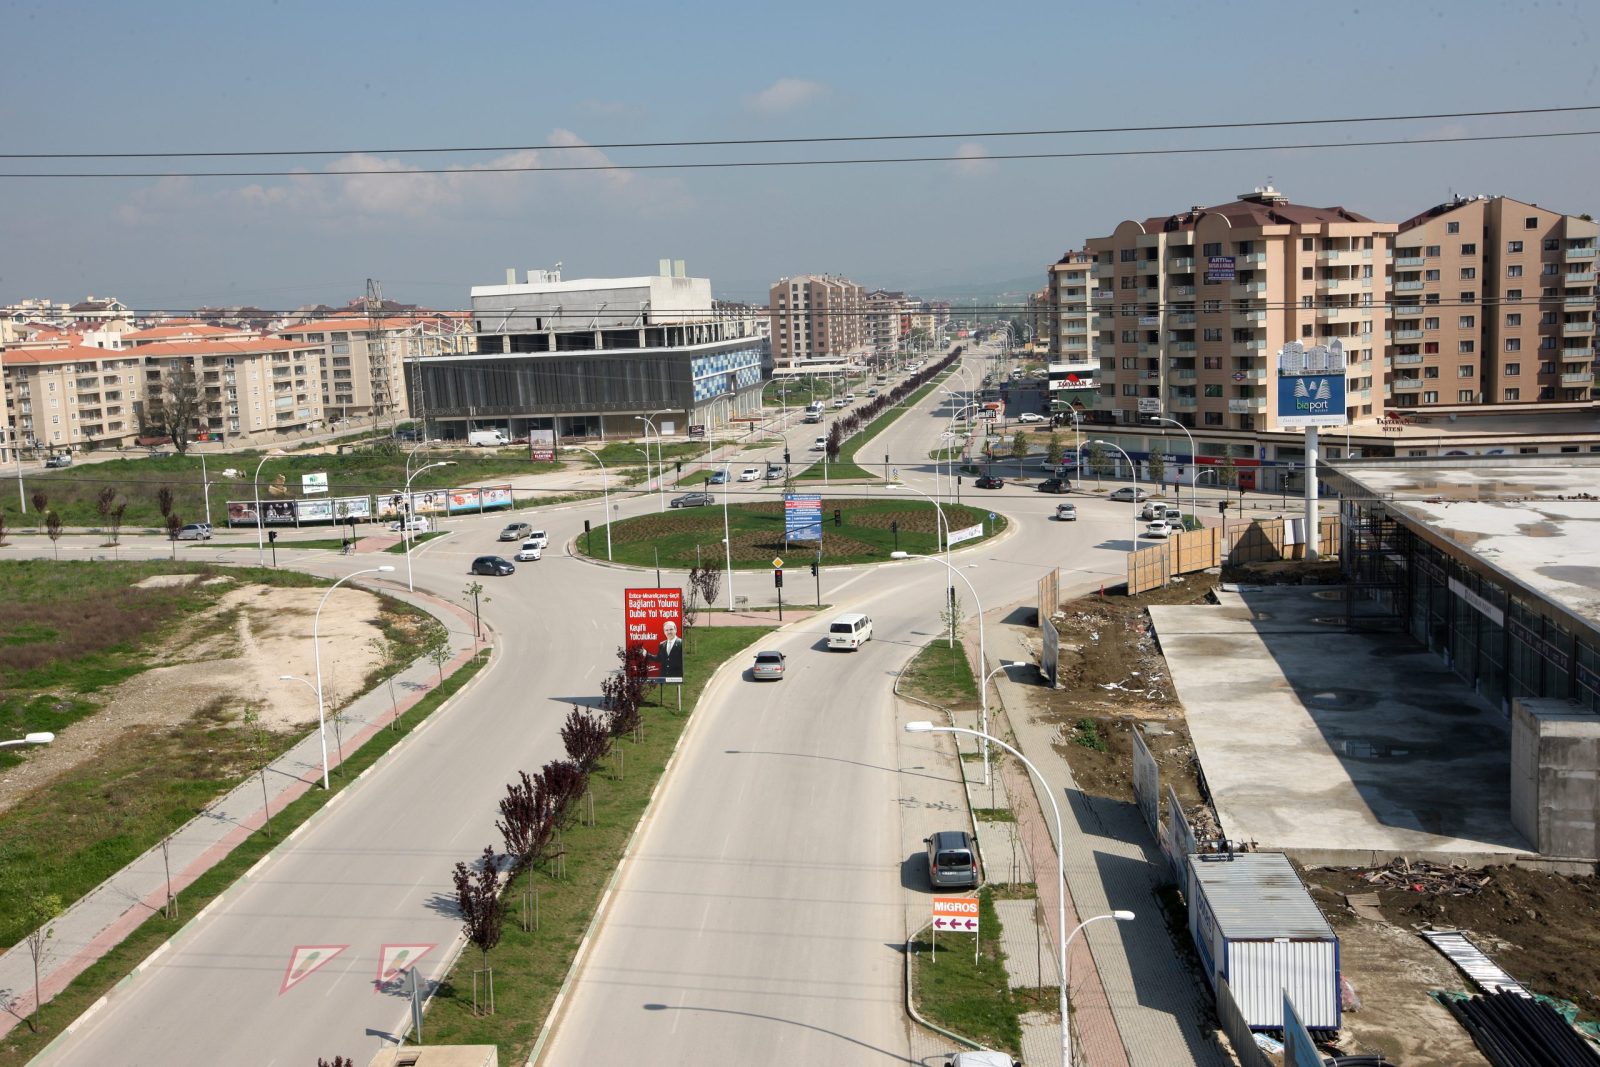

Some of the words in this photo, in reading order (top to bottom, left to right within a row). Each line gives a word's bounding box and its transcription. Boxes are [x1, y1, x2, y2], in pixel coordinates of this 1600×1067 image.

[629, 599, 655, 609] Bağlantı
[658, 599, 678, 607] Yolunu
[629, 610, 646, 618] Duble
[648, 610, 657, 618] Yol
[659, 610, 678, 619] Yaptık
